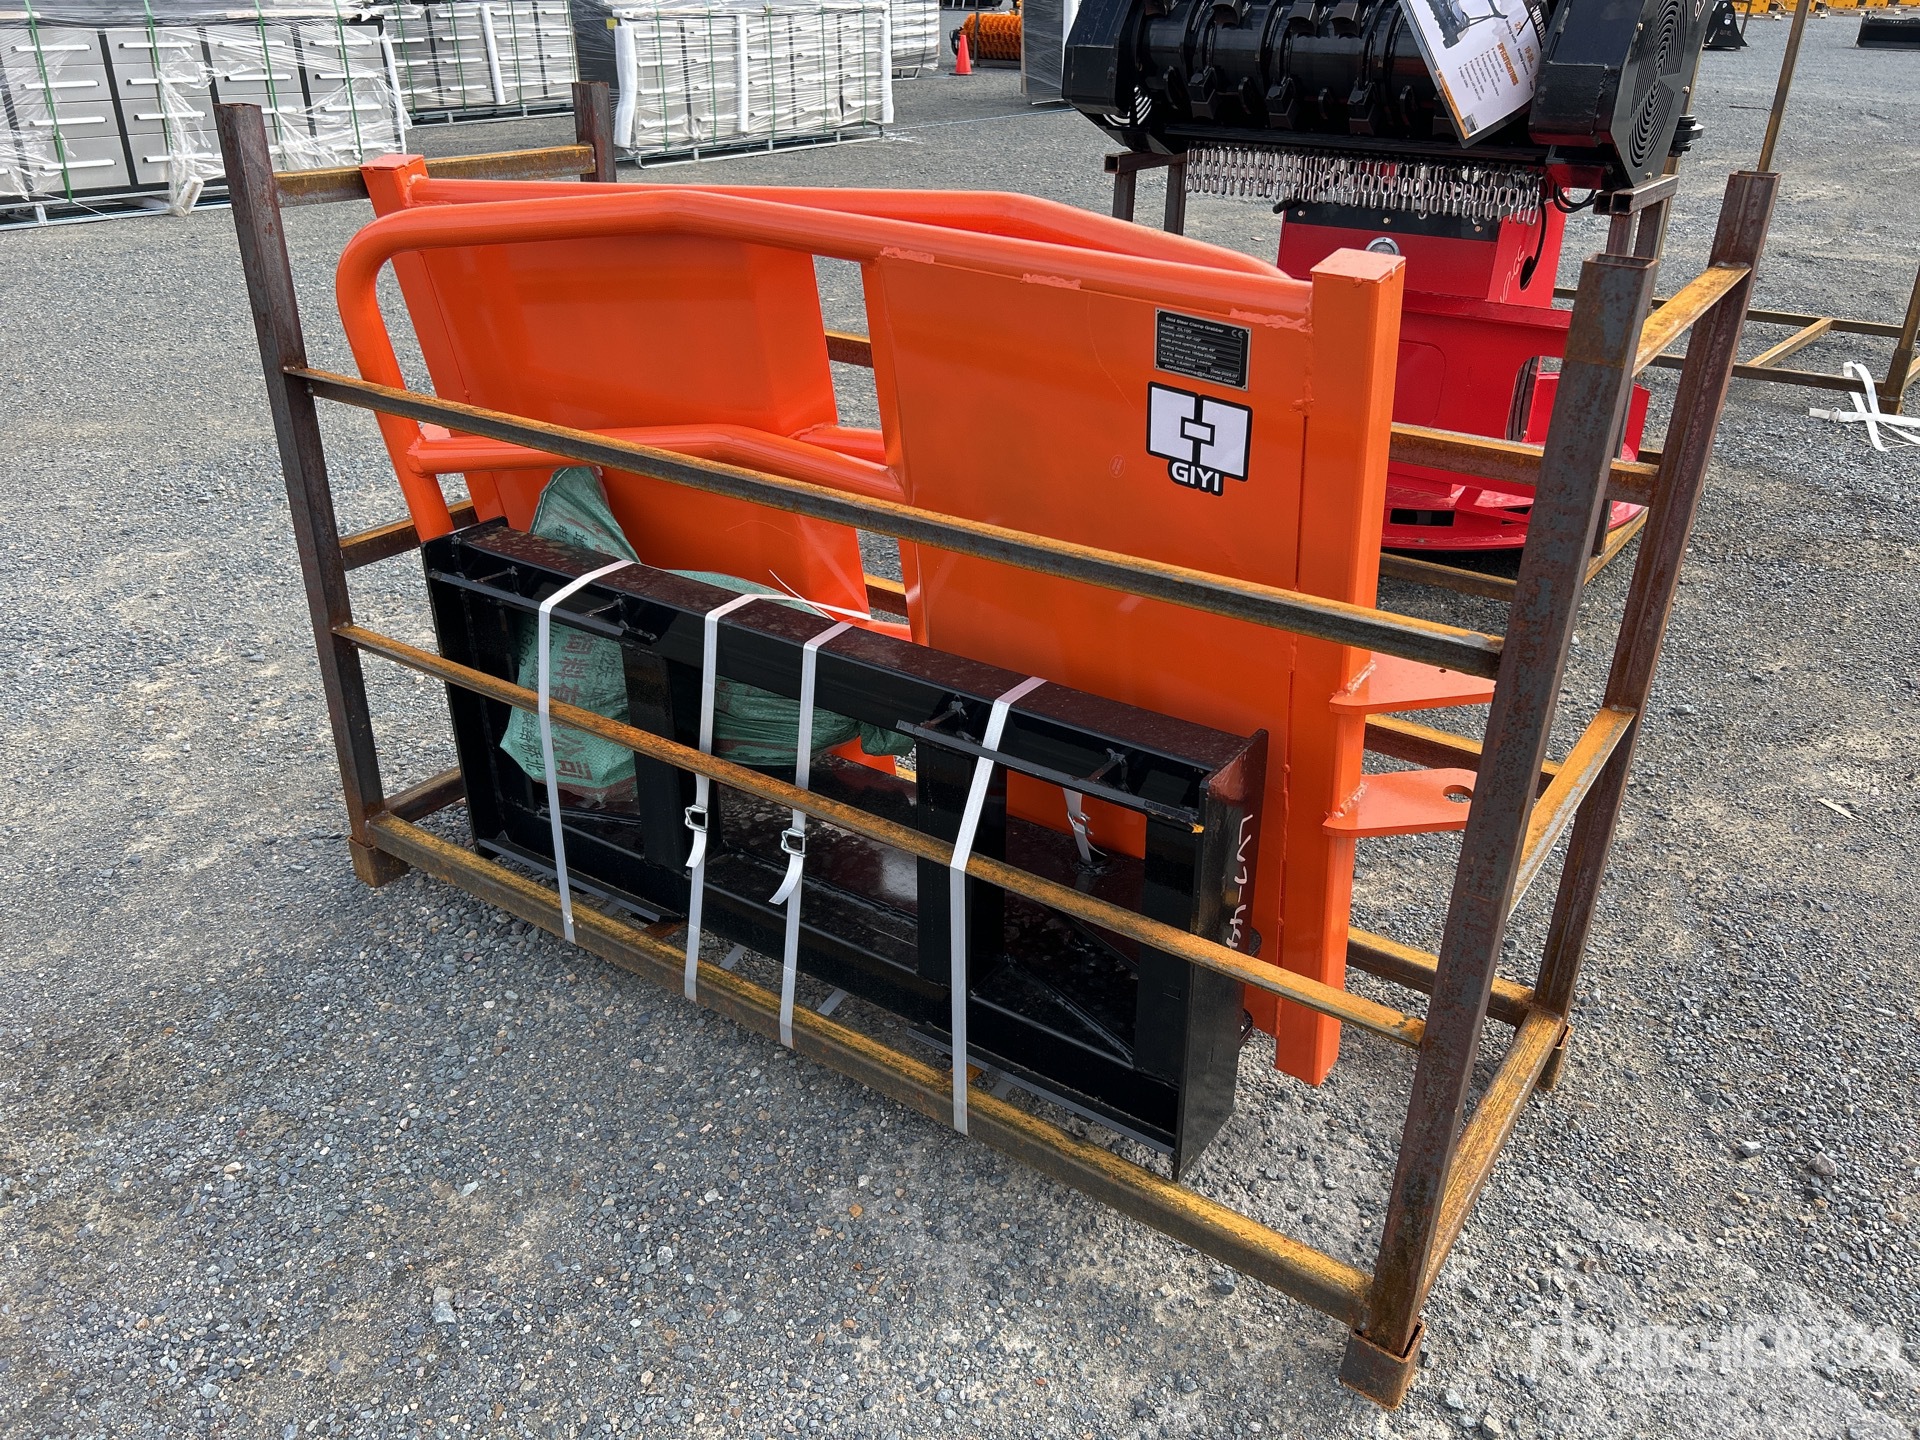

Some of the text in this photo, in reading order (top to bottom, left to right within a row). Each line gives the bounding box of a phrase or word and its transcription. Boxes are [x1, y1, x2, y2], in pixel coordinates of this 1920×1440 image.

[1497, 42, 1518, 86] SPECIFICATIONS
[1172, 461, 1220, 492] GIYI
[549, 633, 593, 780] 饲料有公司
